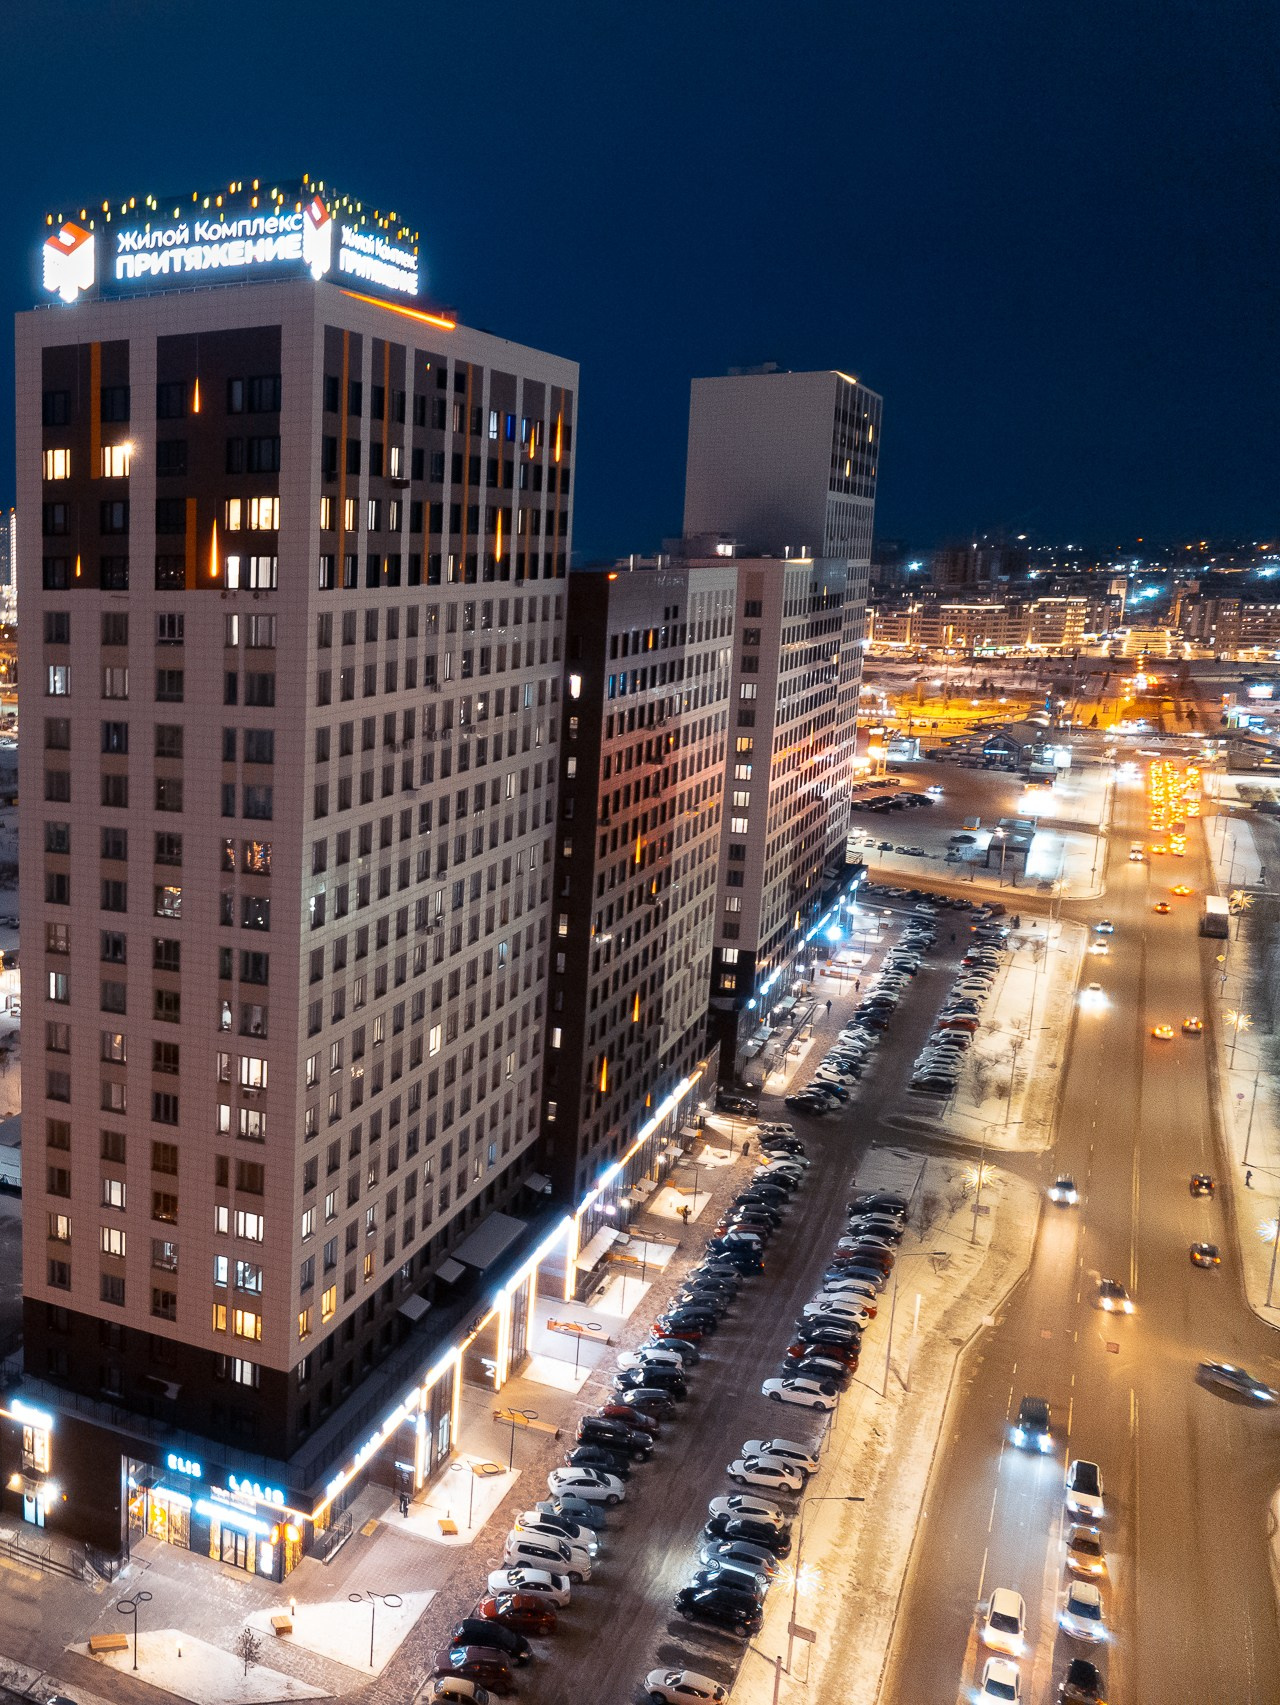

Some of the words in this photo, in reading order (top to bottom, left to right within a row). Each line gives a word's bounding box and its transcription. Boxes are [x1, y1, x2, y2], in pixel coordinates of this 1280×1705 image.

[117, 223, 190, 253] Жилой
[194, 213, 303, 242] Комплекс
[115, 233, 303, 280] ПРИТЯЖЕНИЕ
